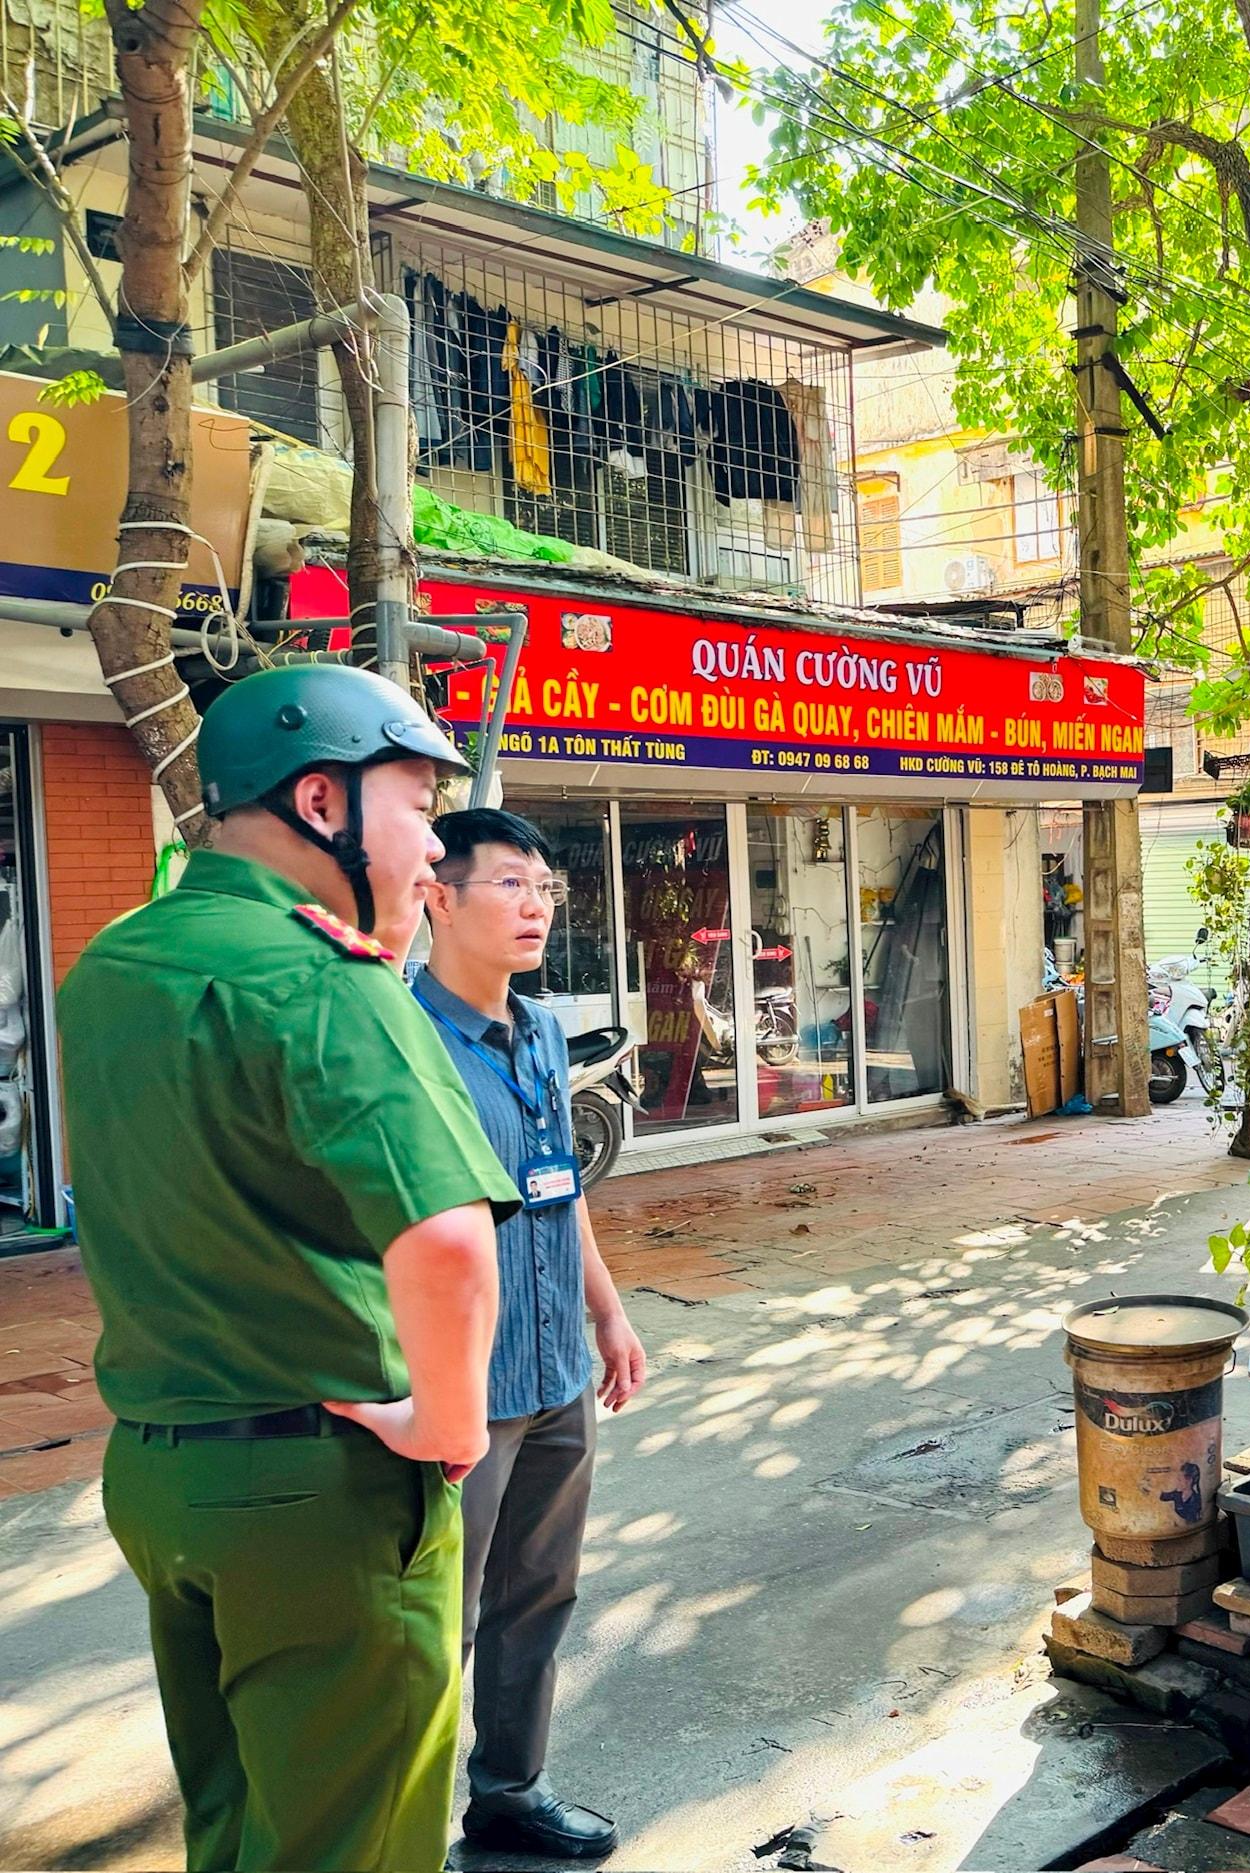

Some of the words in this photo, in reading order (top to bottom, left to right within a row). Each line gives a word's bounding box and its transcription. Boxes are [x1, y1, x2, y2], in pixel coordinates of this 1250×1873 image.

[8, 411, 71, 496] 2
[692, 634, 786, 682] QUÁN
[796, 645, 898, 693] CƯỜNG
[905, 656, 942, 697] VŨ
[481, 666, 533, 715] GẢ
[542, 667, 600, 719] CẦY
[630, 683, 693, 726] CƠM
[701, 686, 746, 730] ĐÙI
[753, 691, 786, 733] GÀ
[793, 700, 860, 743] QUAY,
[866, 703, 930, 742] CHIÊN
[936, 704, 984, 745] MẮM
[1004, 711, 1047, 754] BÚN,
[1052, 713, 1096, 752] MIẾN
[1100, 723, 1144, 754] NGAN
[498, 730, 533, 753] NGÕ
[537, 735, 560, 754] 1A
[563, 733, 597, 756] TÔN
[600, 734, 642, 758] THẤT
[645, 738, 687, 761] TÙNG
[751, 749, 775, 765] ĐT:
[777, 751, 811, 768] 0947
[814, 753, 832, 768] 09
[834, 754, 851, 770] 68
[853, 755, 870, 770] 68
[899, 756, 924, 772] HKD
[926, 755, 965, 774] CƯỜNG
[966, 757, 987, 774] VŨ:
[988, 760, 1009, 776] 158
[1026, 760, 1041, 776] TÔ
[1042, 760, 1079, 779] HOÀNG,
[1080, 764, 1091, 778] P.
[1092, 764, 1118, 781] BẠCH
[1119, 765, 1138, 780] MAI
[647, 1010, 692, 1044] GAN
[1104, 1412, 1166, 1433] Dulux
